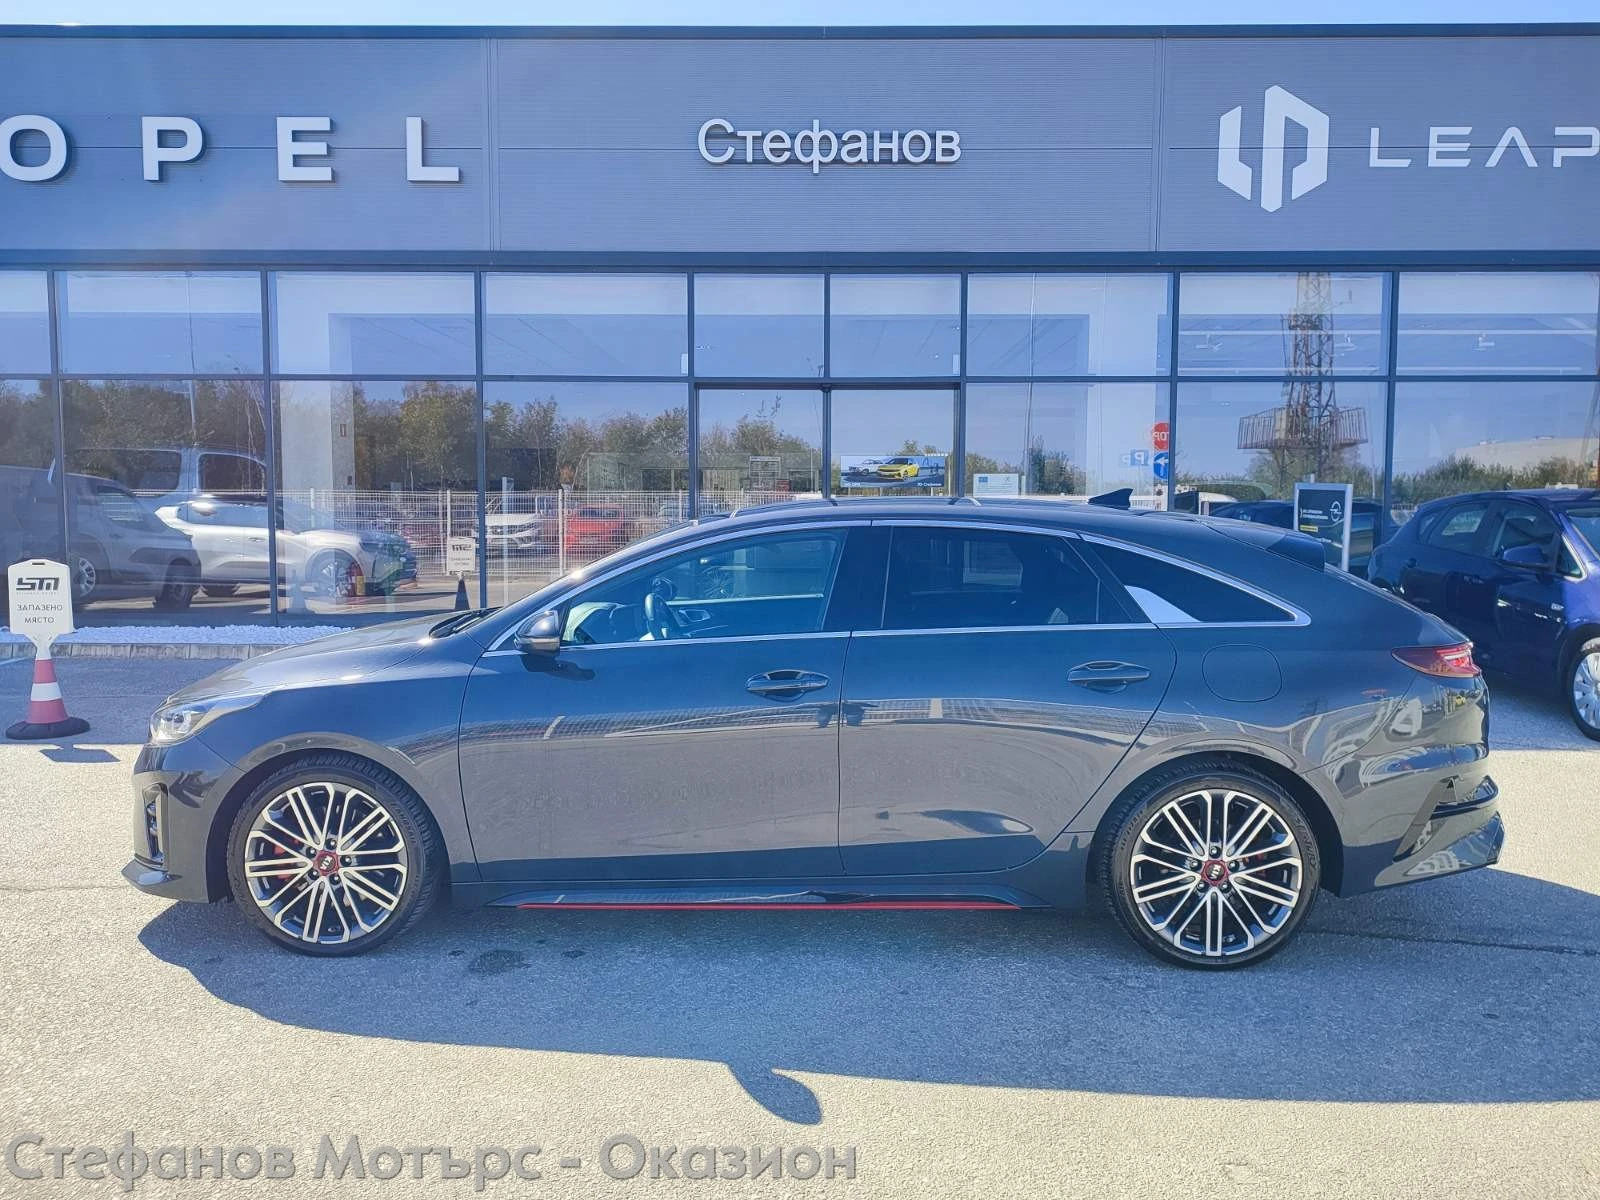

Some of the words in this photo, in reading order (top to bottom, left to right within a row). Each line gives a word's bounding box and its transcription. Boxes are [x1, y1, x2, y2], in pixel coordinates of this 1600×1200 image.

[0, 115, 461, 182] OPEL
[697, 118, 962, 173] Стефанов
[1368, 126, 1600, 168] LEAP
